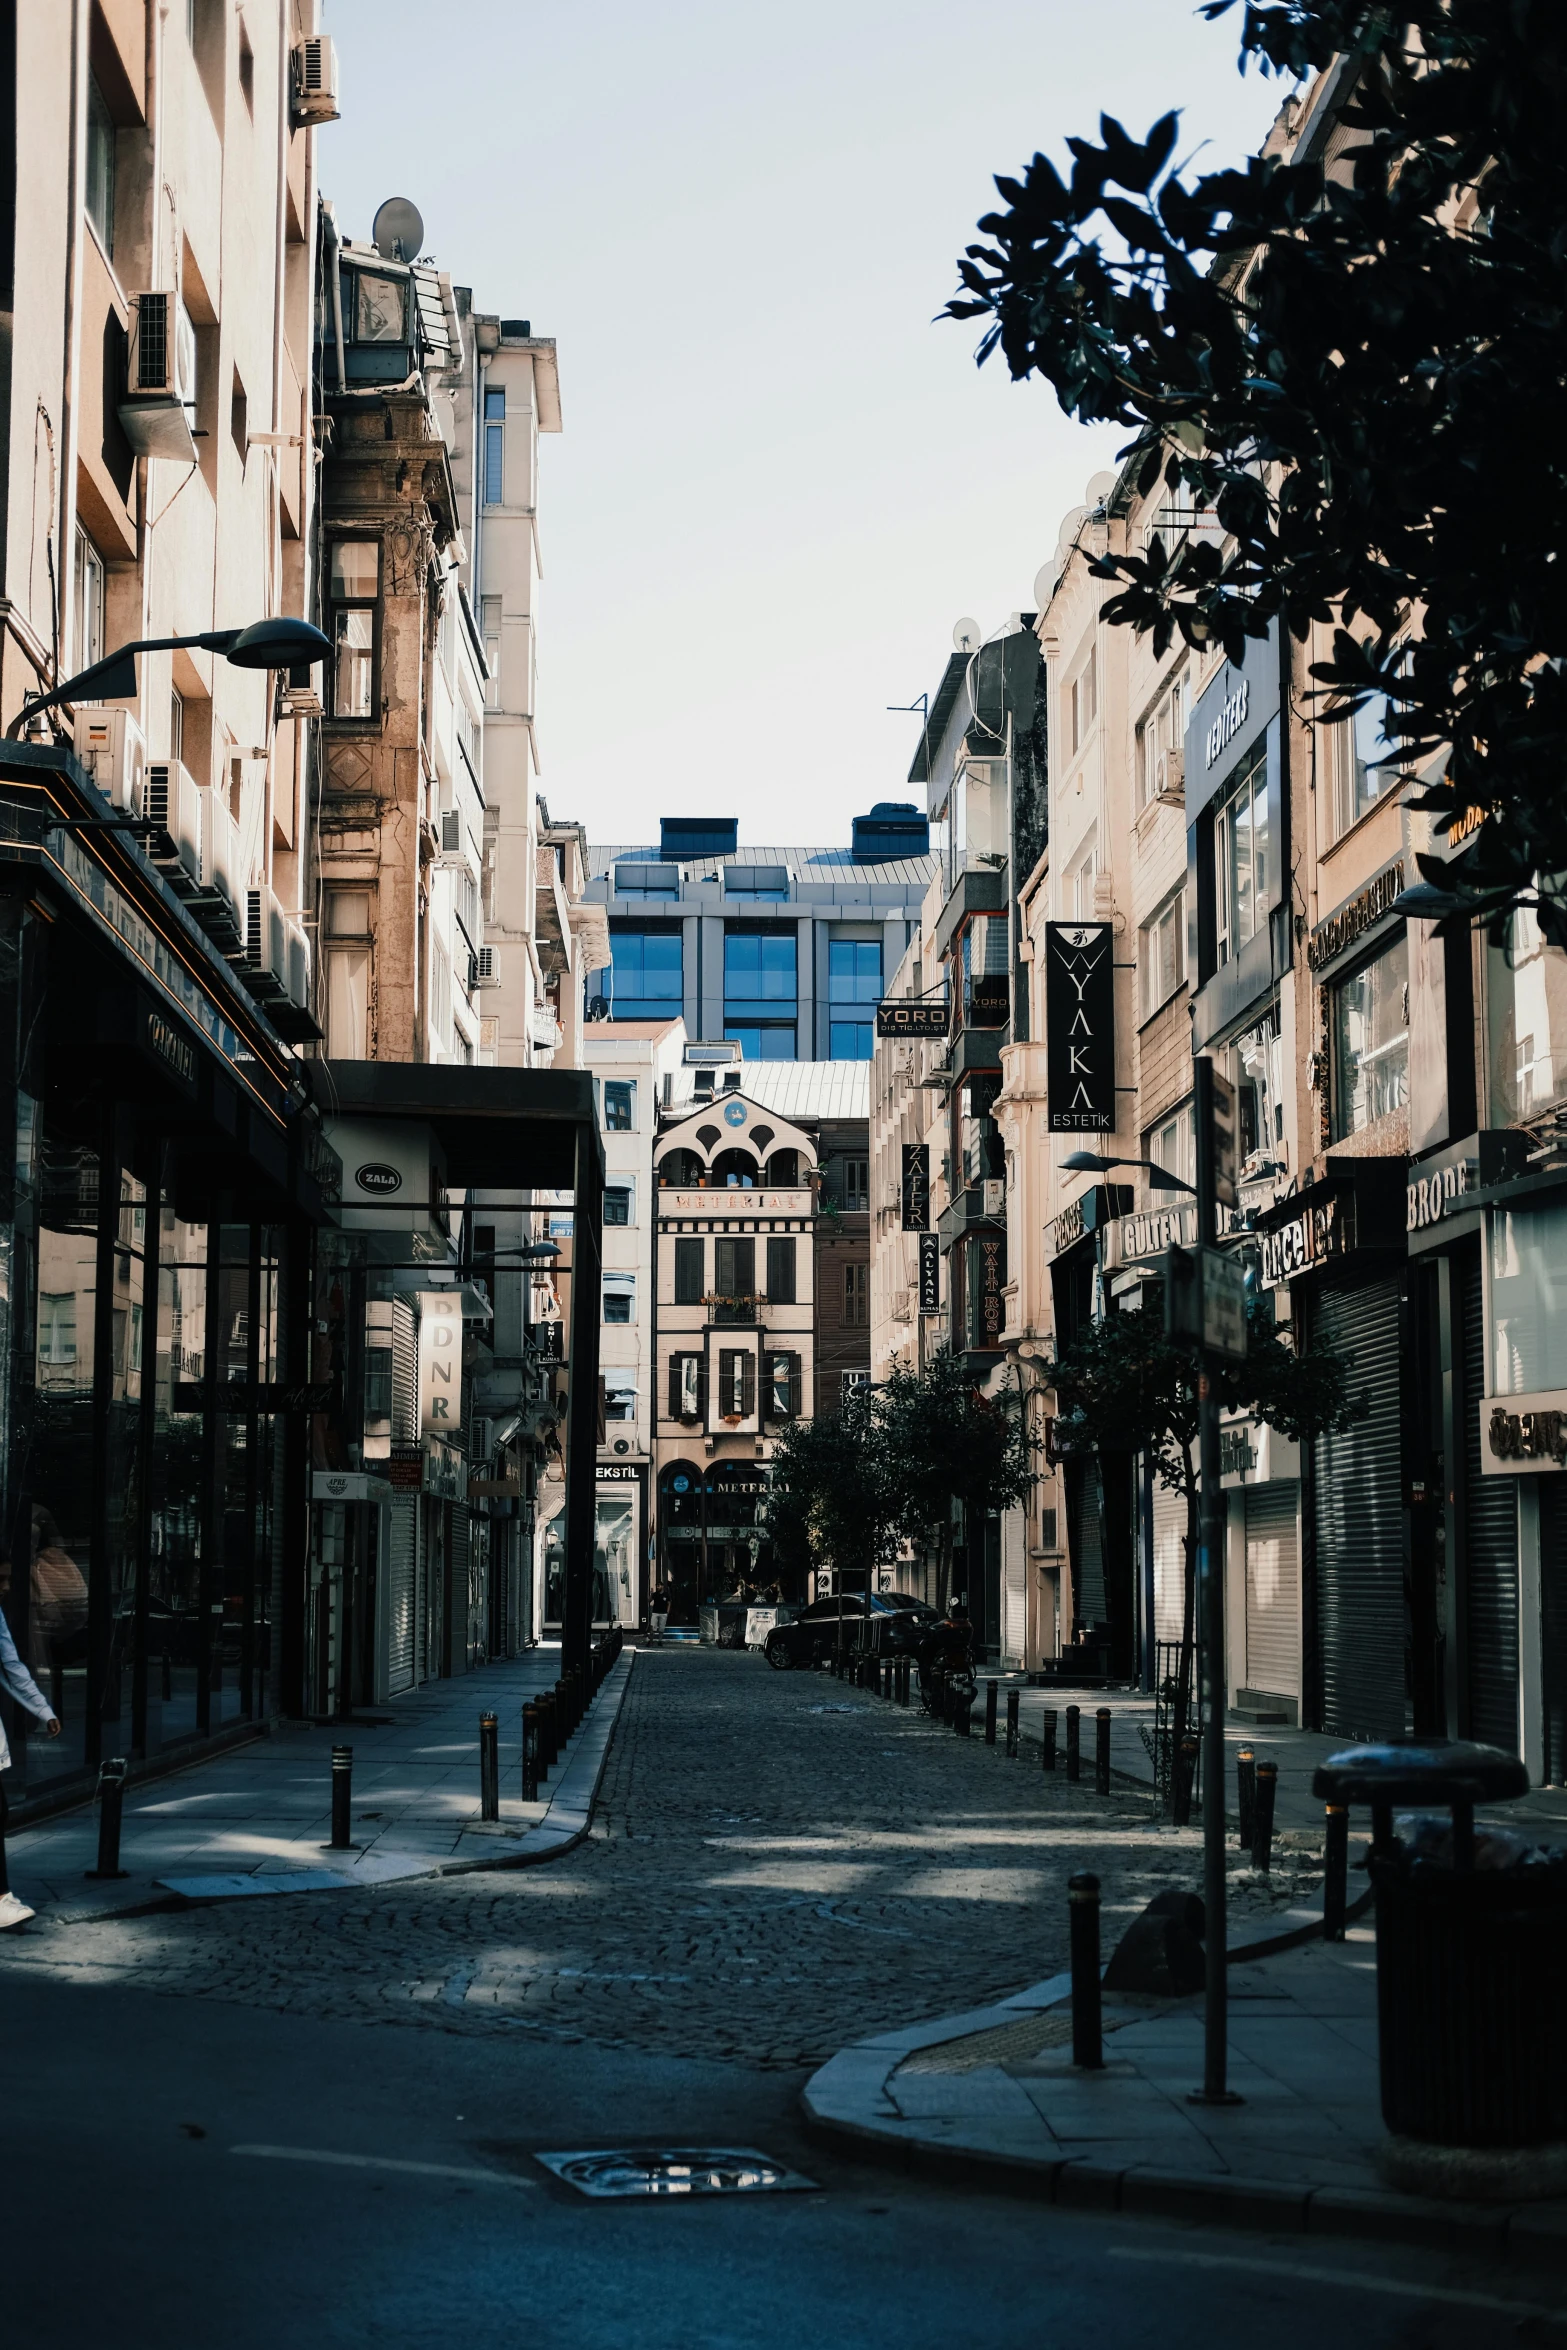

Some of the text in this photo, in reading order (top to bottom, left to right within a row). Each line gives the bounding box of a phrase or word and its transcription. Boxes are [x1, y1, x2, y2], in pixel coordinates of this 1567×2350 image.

[879, 1010, 945, 1023] YORO
[973, 998, 1007, 1006] YORO
[1053, 1113, 1110, 1126] ESTETİK
[908, 1145, 924, 1224] ZAFER
[1124, 1212, 1183, 1257] GÜLTEN
[925, 1252, 934, 1304] ALYANS
